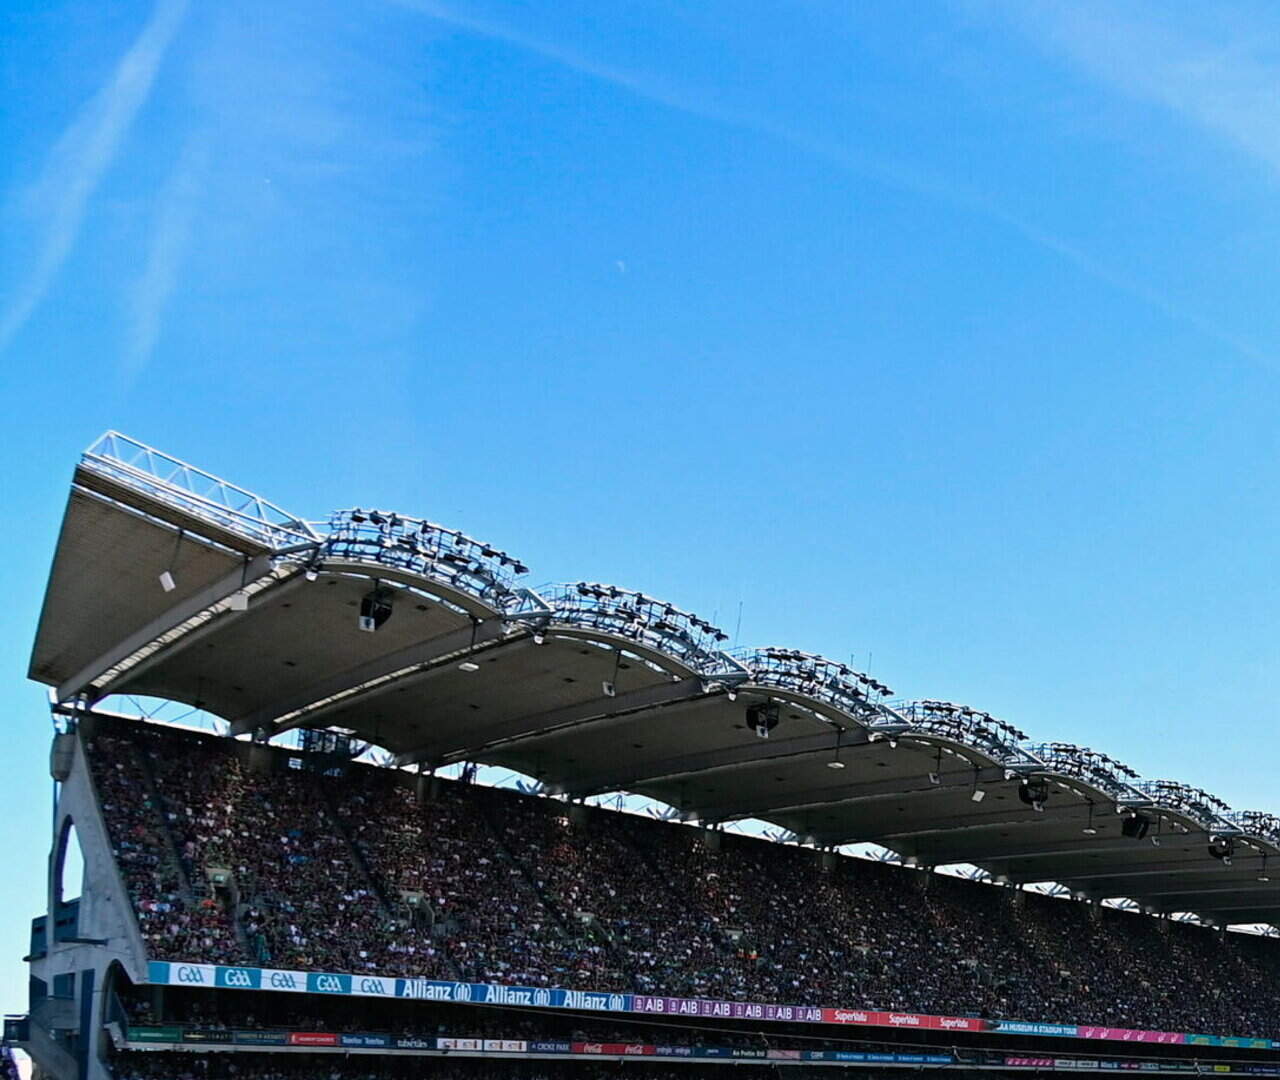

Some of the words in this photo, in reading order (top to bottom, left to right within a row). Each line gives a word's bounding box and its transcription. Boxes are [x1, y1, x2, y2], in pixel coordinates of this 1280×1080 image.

[402, 980, 451, 999] Allianz
[485, 986, 531, 1004] Allianz
[564, 991, 606, 1010] Allianz
[645, 998, 664, 1012] AIB
[680, 1001, 698, 1014] AIB
[713, 1002, 731, 1016] AIB
[745, 1004, 762, 1018] AIB
[775, 1006, 792, 1020] AIB
[806, 1008, 821, 1021] AIB
[834, 1010, 867, 1023] SuperValu
[888, 1015, 919, 1026] SuperValu
[940, 1018, 968, 1028] SuperValu
